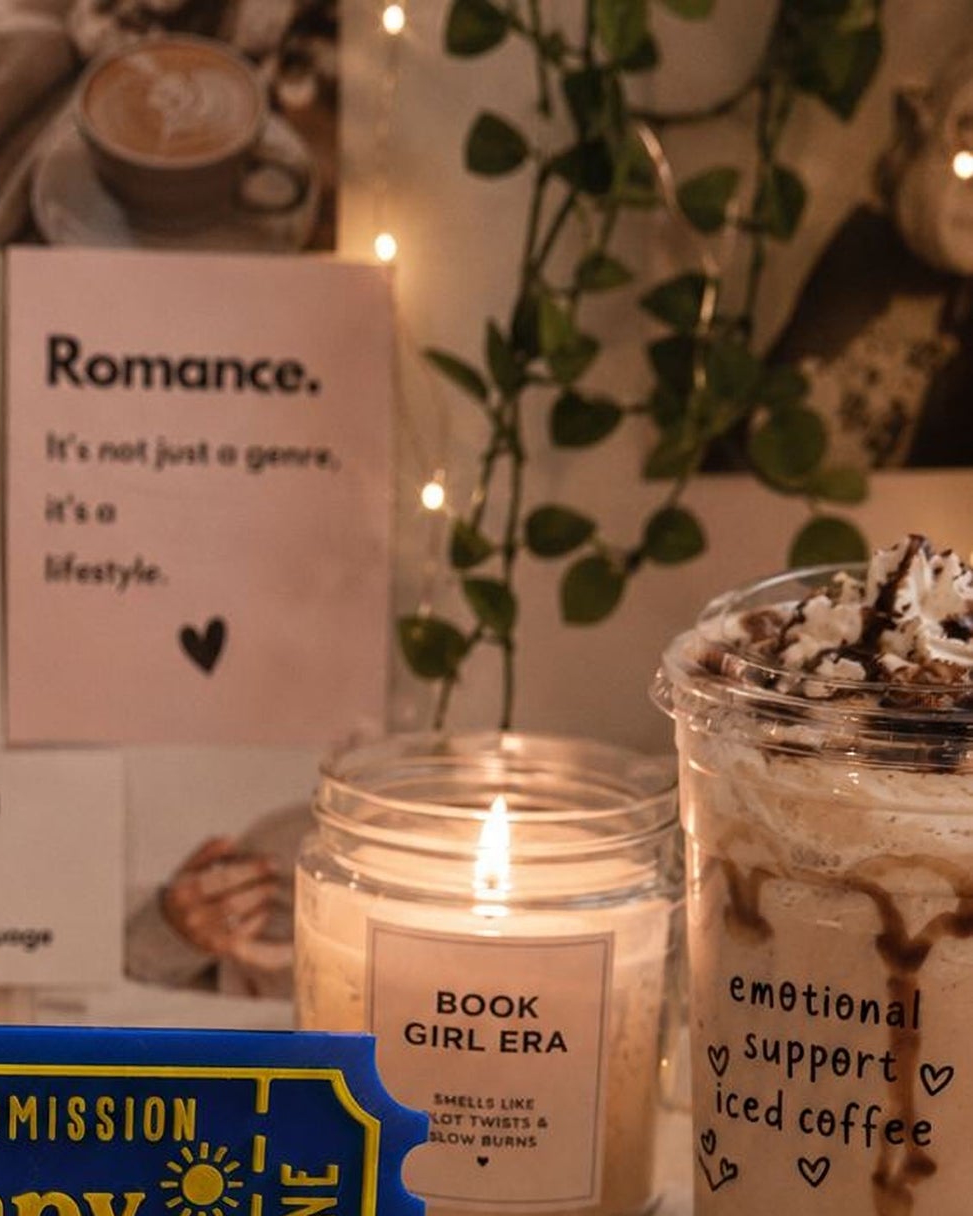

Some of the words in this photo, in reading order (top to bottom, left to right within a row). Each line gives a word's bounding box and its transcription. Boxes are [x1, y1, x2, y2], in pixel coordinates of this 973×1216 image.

[46, 334, 323, 396] Romance.
[45, 433, 90, 462] It's
[97, 438, 148, 463] not
[153, 438, 209, 472] just
[217, 446, 238, 466] a
[45, 496, 89, 523] it's
[95, 503, 117, 524] a
[436, 990, 539, 1018] BOOK
[730, 976, 921, 1030] emotional
[403, 1022, 486, 1051] GIRL
[499, 1029, 568, 1053] ERA
[744, 1032, 898, 1083] support
[433, 1093, 495, 1110] SMELLS
[501, 1097, 535, 1111] LIKE
[716, 1082, 783, 1131] iced
[798, 1102, 932, 1148] coffee
[469, 1114, 531, 1130] TWISTS
[537, 1116, 548, 1129] &
[480, 1134, 538, 1149] BURNS
